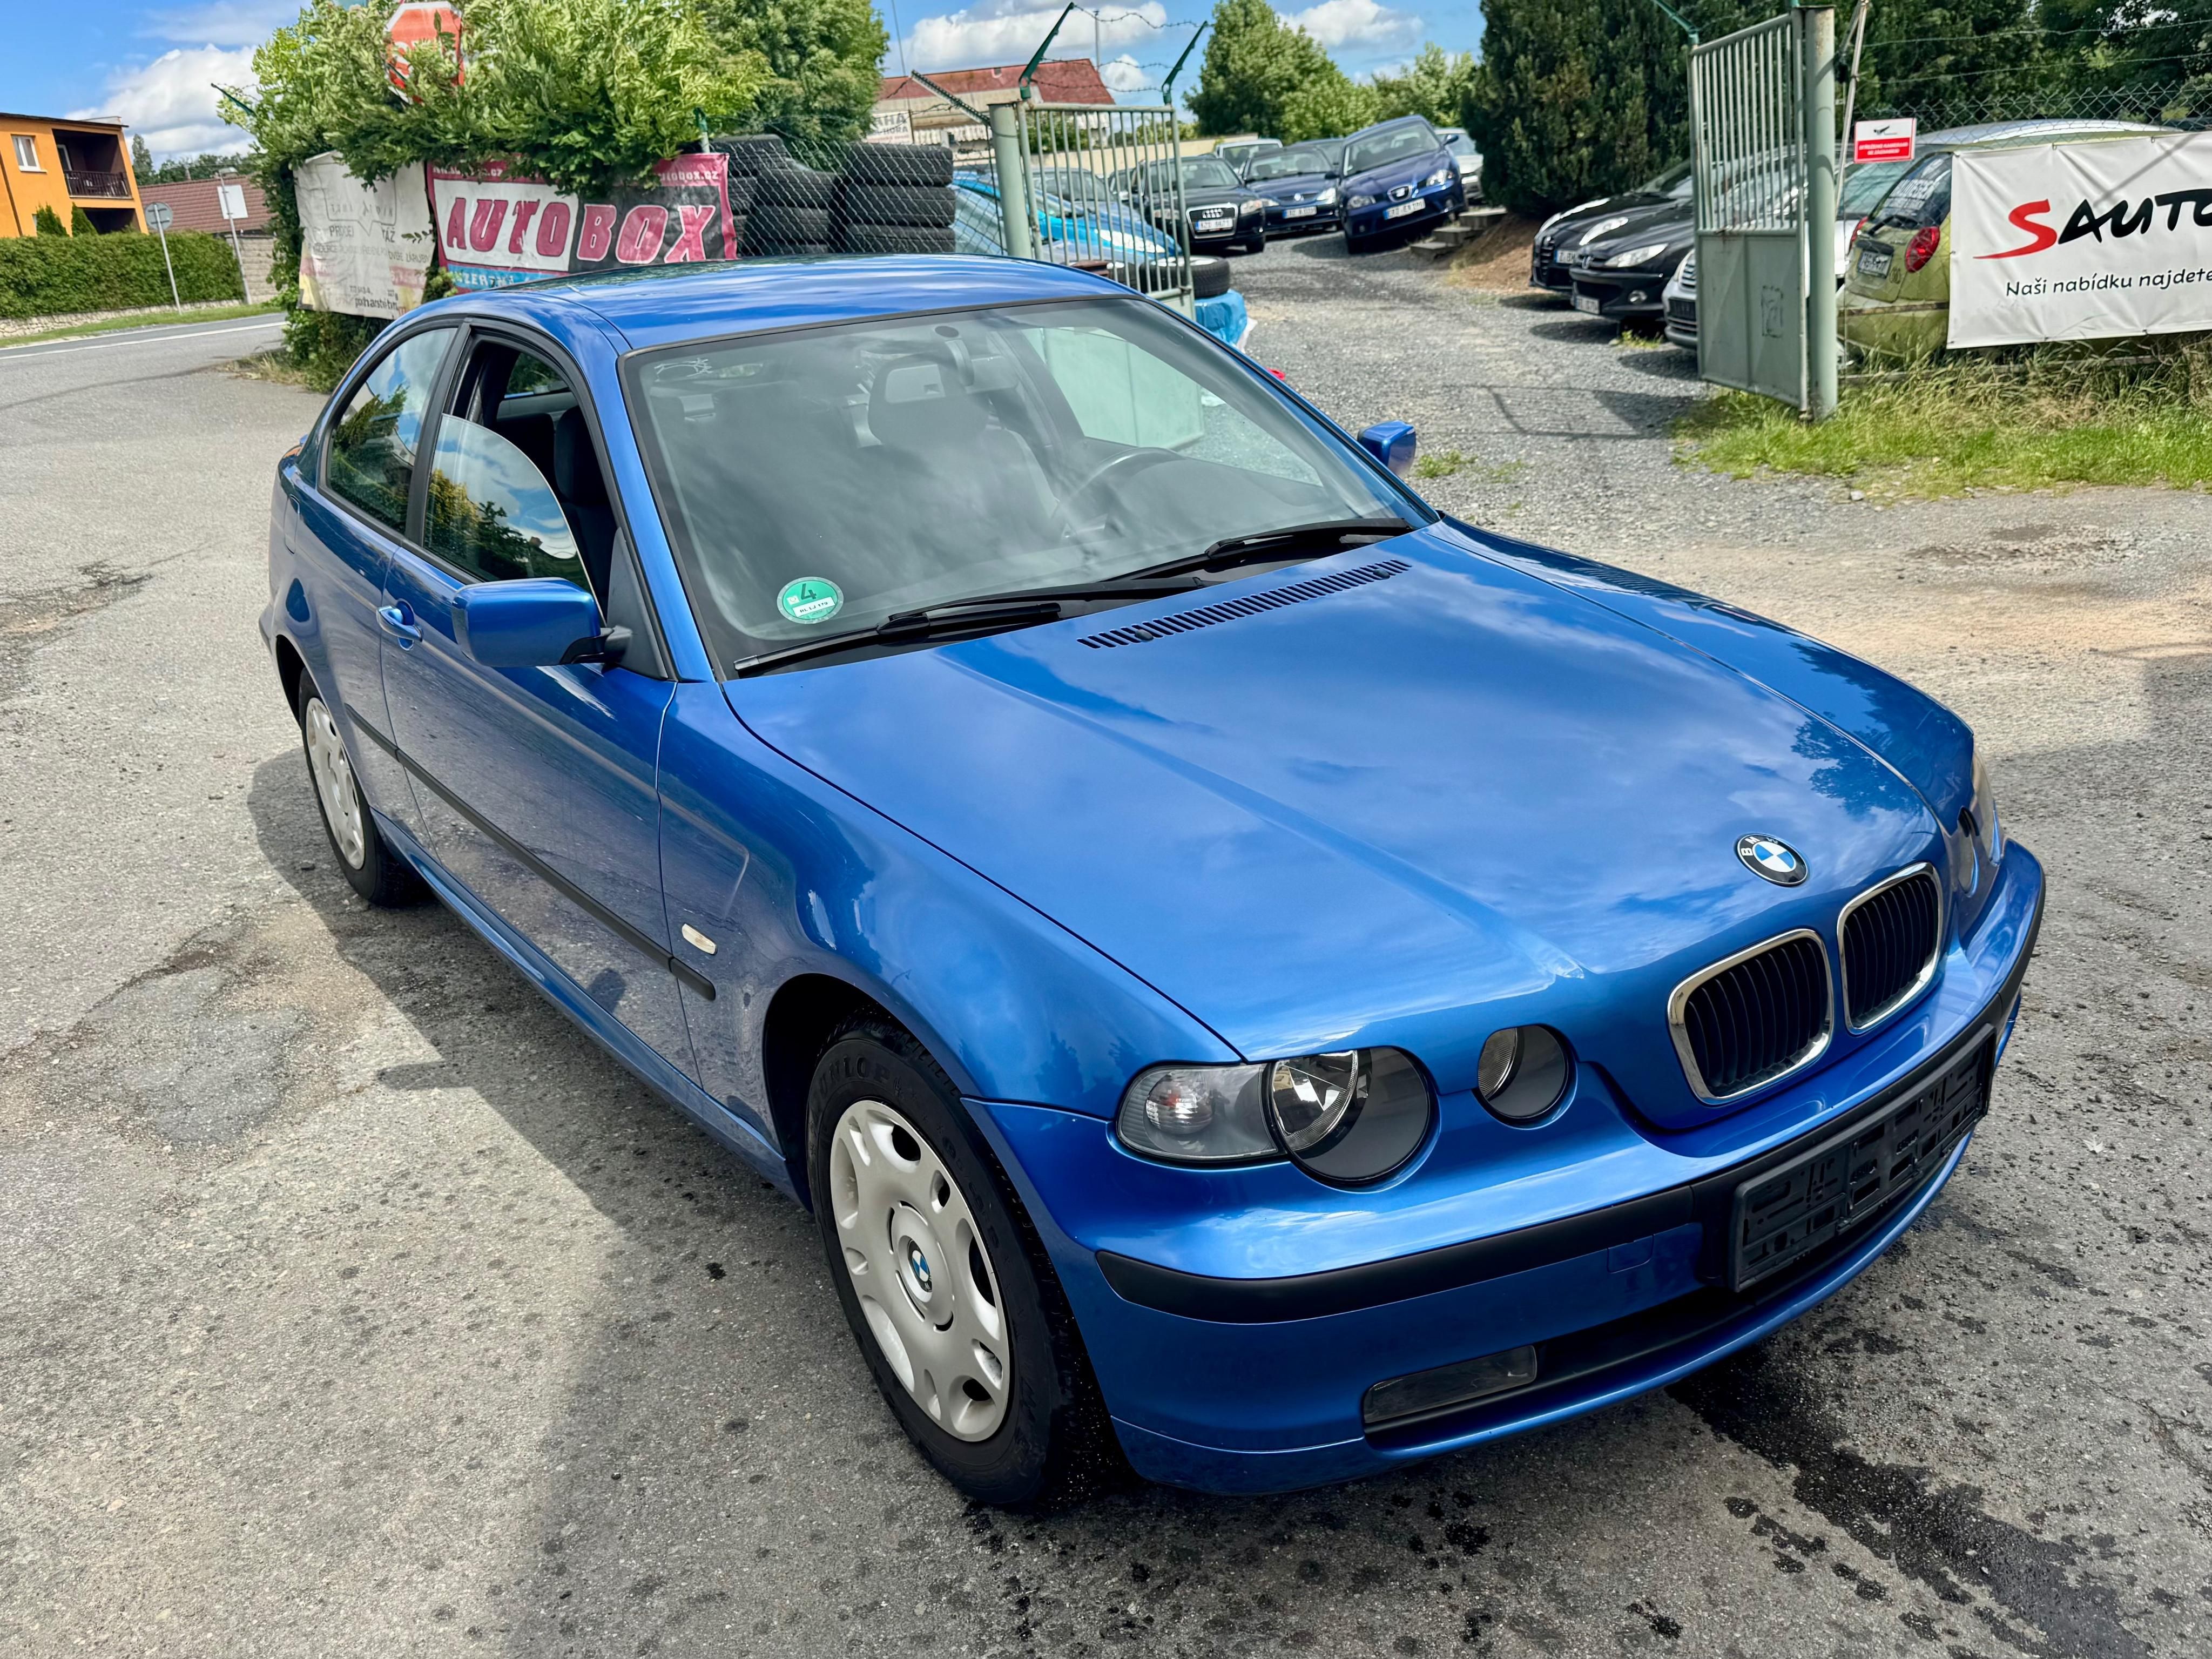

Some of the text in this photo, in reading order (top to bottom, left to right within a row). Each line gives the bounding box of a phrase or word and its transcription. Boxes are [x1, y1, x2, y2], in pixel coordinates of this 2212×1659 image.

[447, 197, 716, 264] AUTOBOX
[2006, 268, 2212, 296] Naši nabídku najdete
[801, 583, 817, 600] 4
[1741, 837, 1778, 856] BMW
